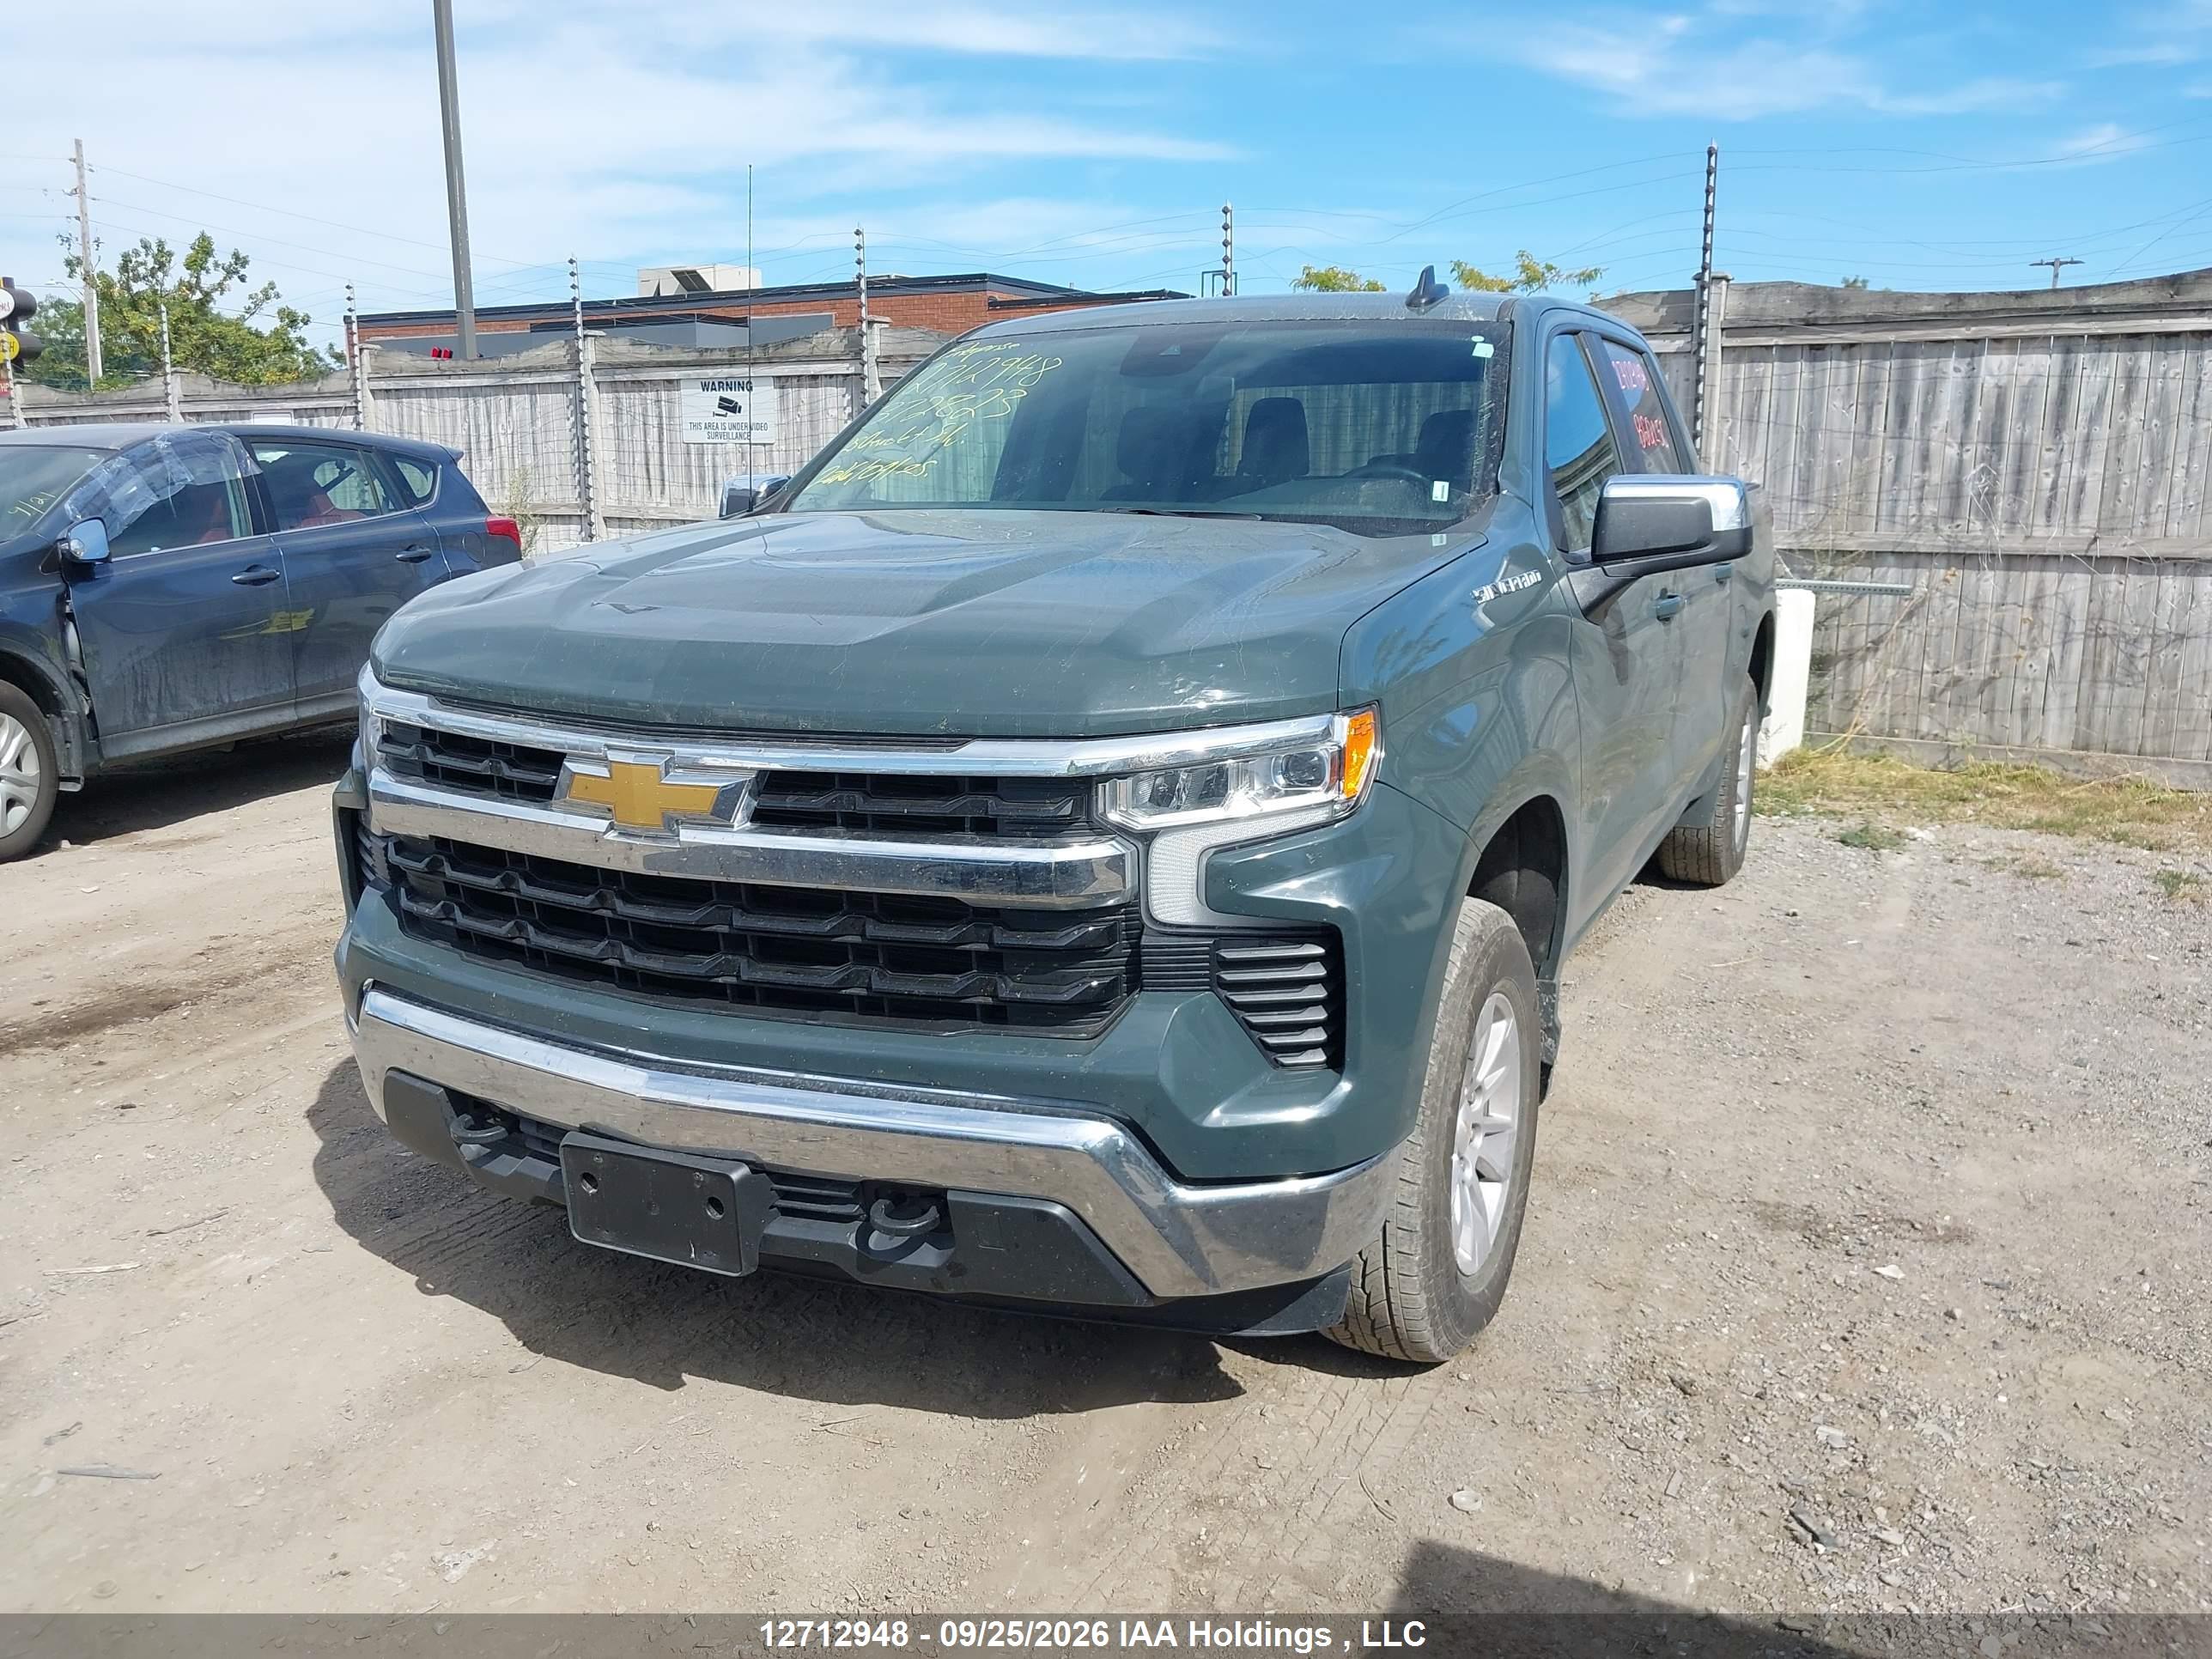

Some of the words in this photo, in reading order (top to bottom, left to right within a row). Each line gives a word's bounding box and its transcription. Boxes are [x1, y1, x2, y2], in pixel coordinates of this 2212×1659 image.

[701, 380, 753, 392] WARNING
[690, 422, 702, 430] THIS
[704, 422, 719, 430] AREA
[721, 422, 726, 430] IS
[728, 422, 748, 430] UNDER
[750, 422, 769, 431] VIDEO
[707, 431, 750, 441] SURVEILLANCE
